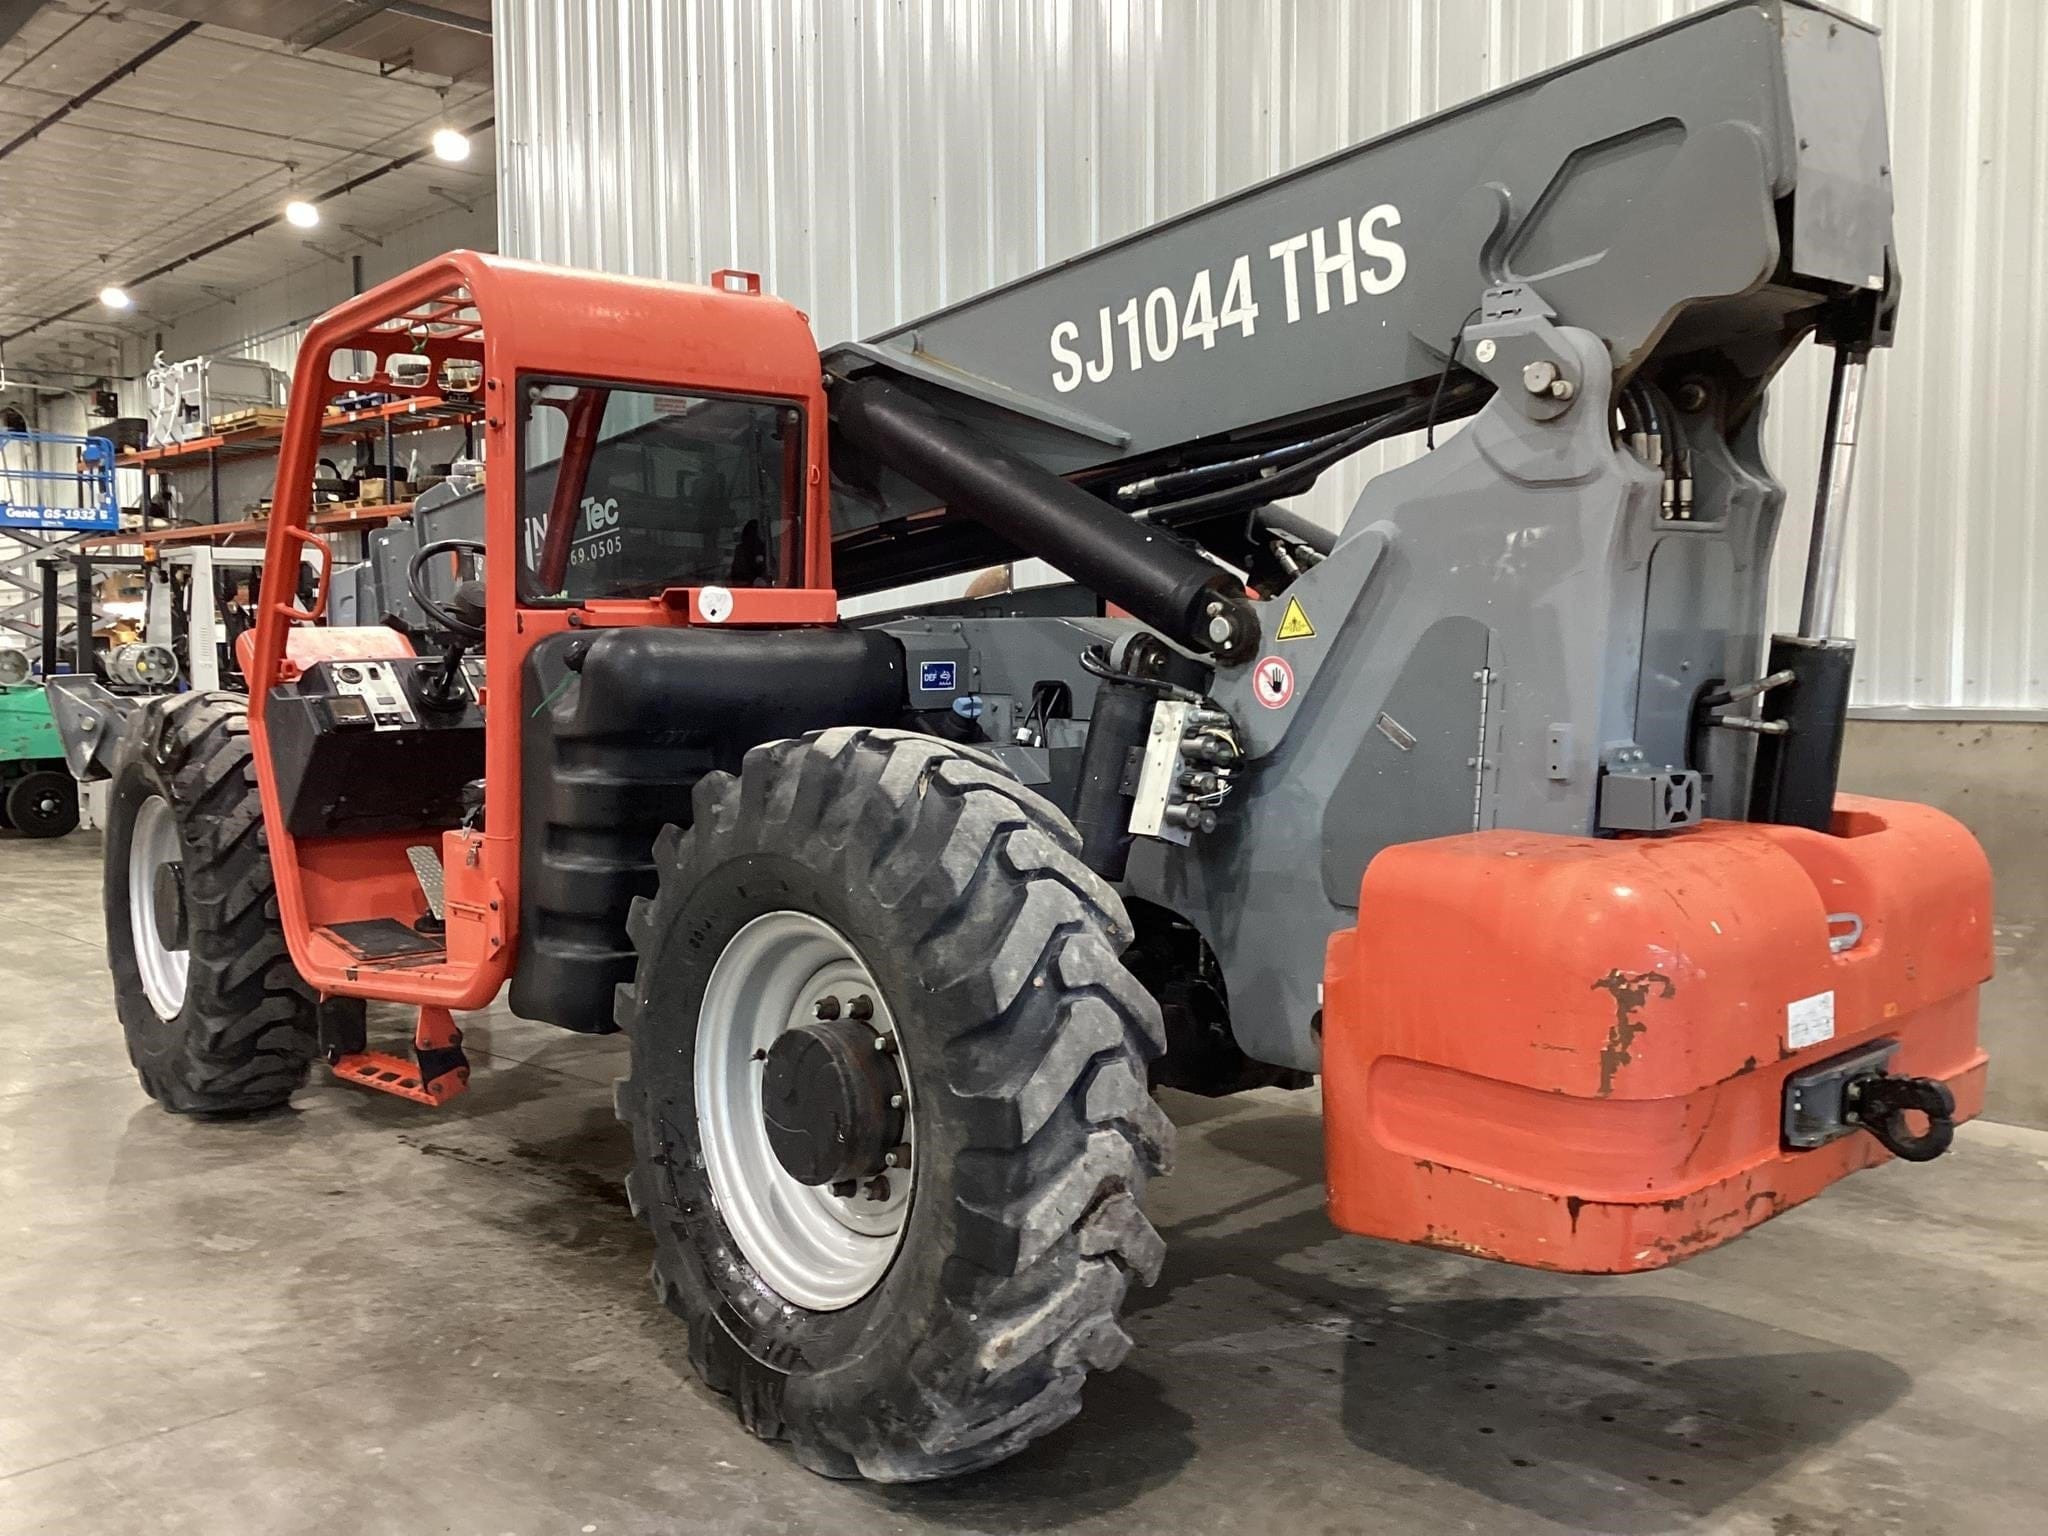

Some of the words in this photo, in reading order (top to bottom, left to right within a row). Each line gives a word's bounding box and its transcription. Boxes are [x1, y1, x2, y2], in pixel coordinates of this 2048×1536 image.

[1050, 254, 1259, 393] SJ1044
[1269, 203, 1408, 324] THS
[5, 507, 39, 519] Genie
[43, 508, 96, 521] GS-1932
[570, 535, 622, 566] 69.0505
